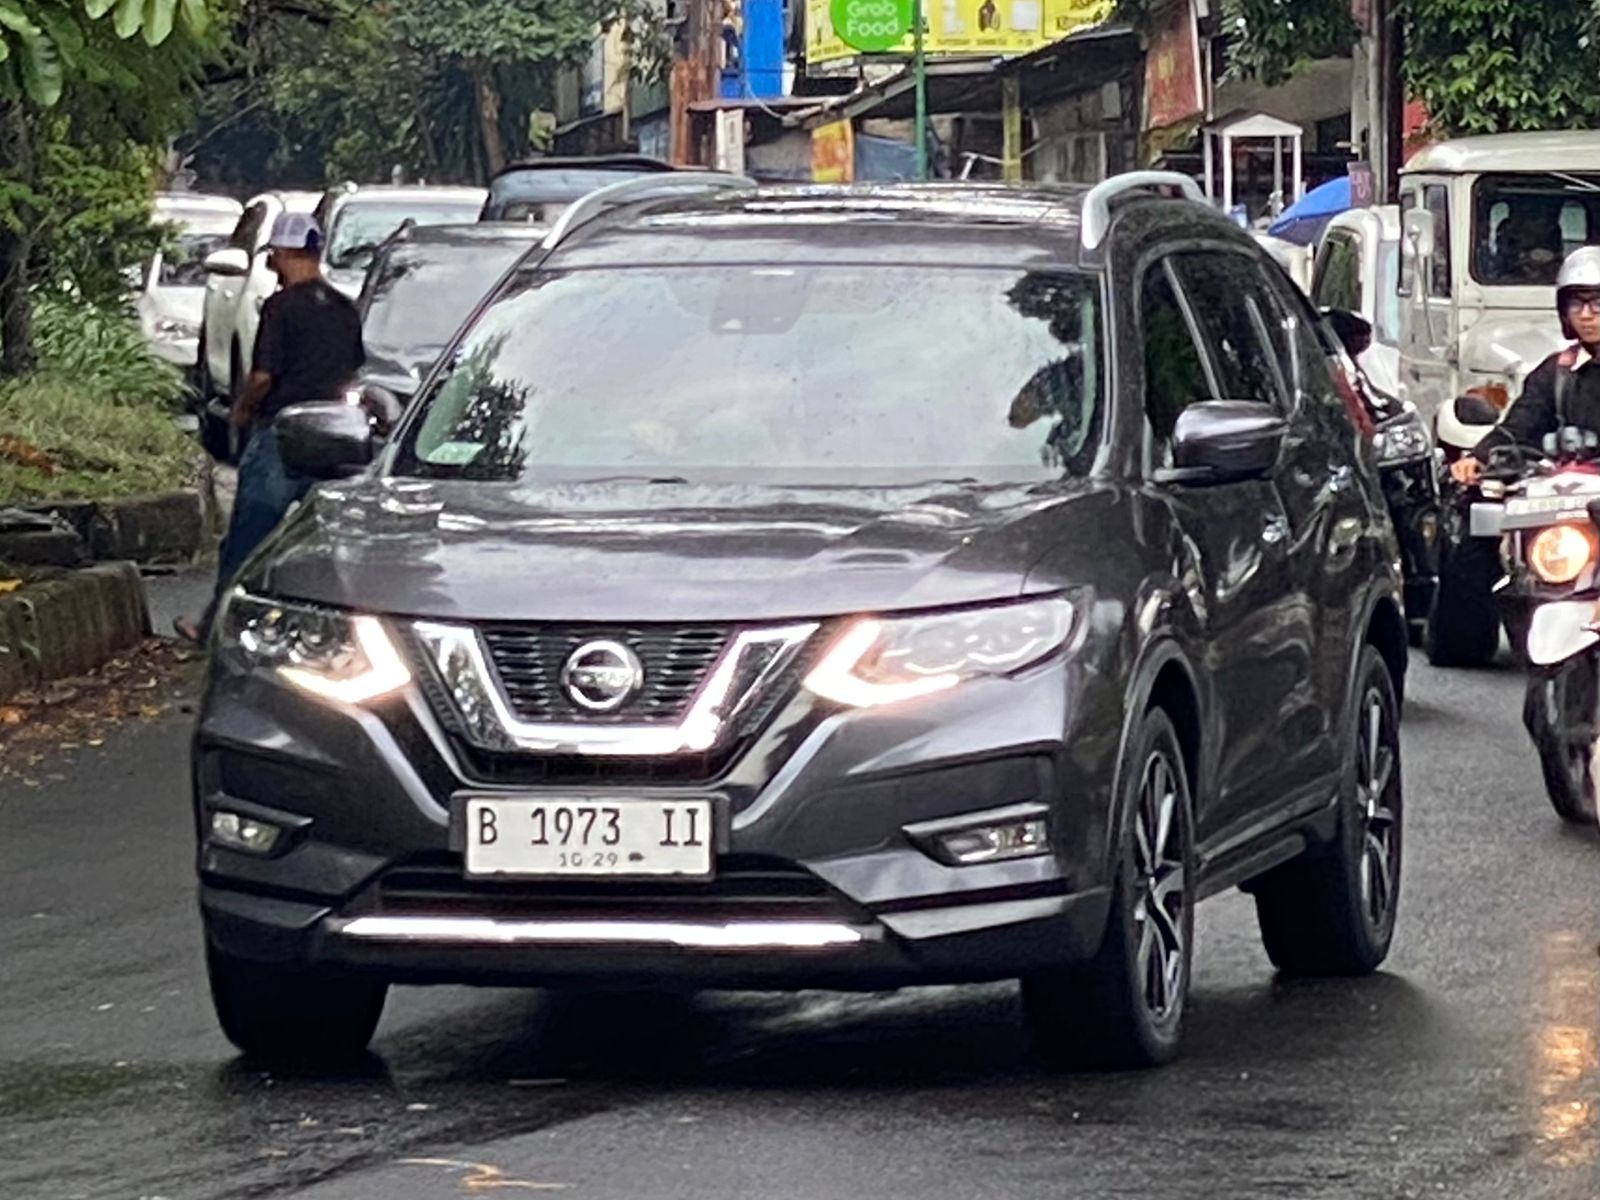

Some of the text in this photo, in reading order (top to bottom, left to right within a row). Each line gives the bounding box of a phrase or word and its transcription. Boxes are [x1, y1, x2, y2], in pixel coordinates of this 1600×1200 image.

[847, 0, 897, 18] Grab
[847, 17, 899, 37] Food
[479, 807, 702, 847] B 1973 II
[559, 852, 618, 867] 10 29
